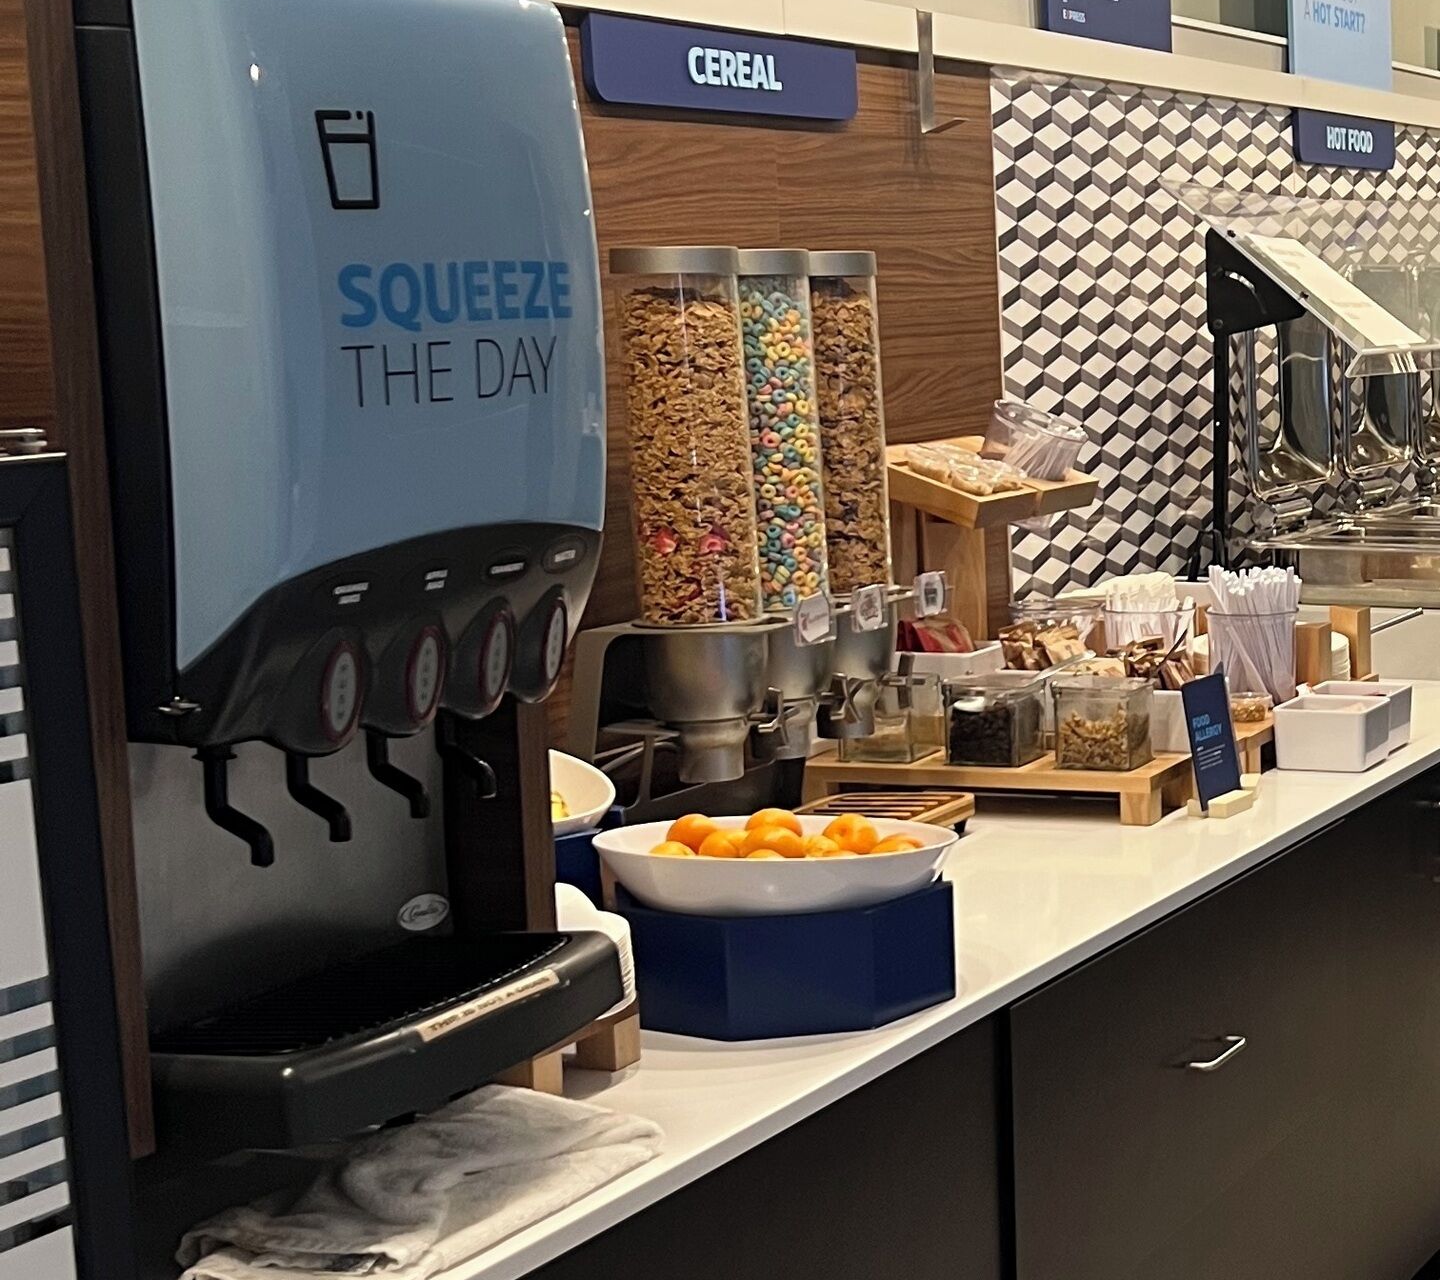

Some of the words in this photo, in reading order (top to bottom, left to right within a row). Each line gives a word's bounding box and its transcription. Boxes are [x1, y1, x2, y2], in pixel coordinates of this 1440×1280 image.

[1313, 0, 1331, 25] HOT
[1334, 6, 1365, 34] START?
[687, 46, 783, 91] CEREAL
[1326, 125, 1347, 150] HOT
[1348, 128, 1373, 153] FOOD
[338, 261, 573, 332] SQUEEZE
[340, 341, 454, 407] THE
[475, 336, 557, 398] DAY
